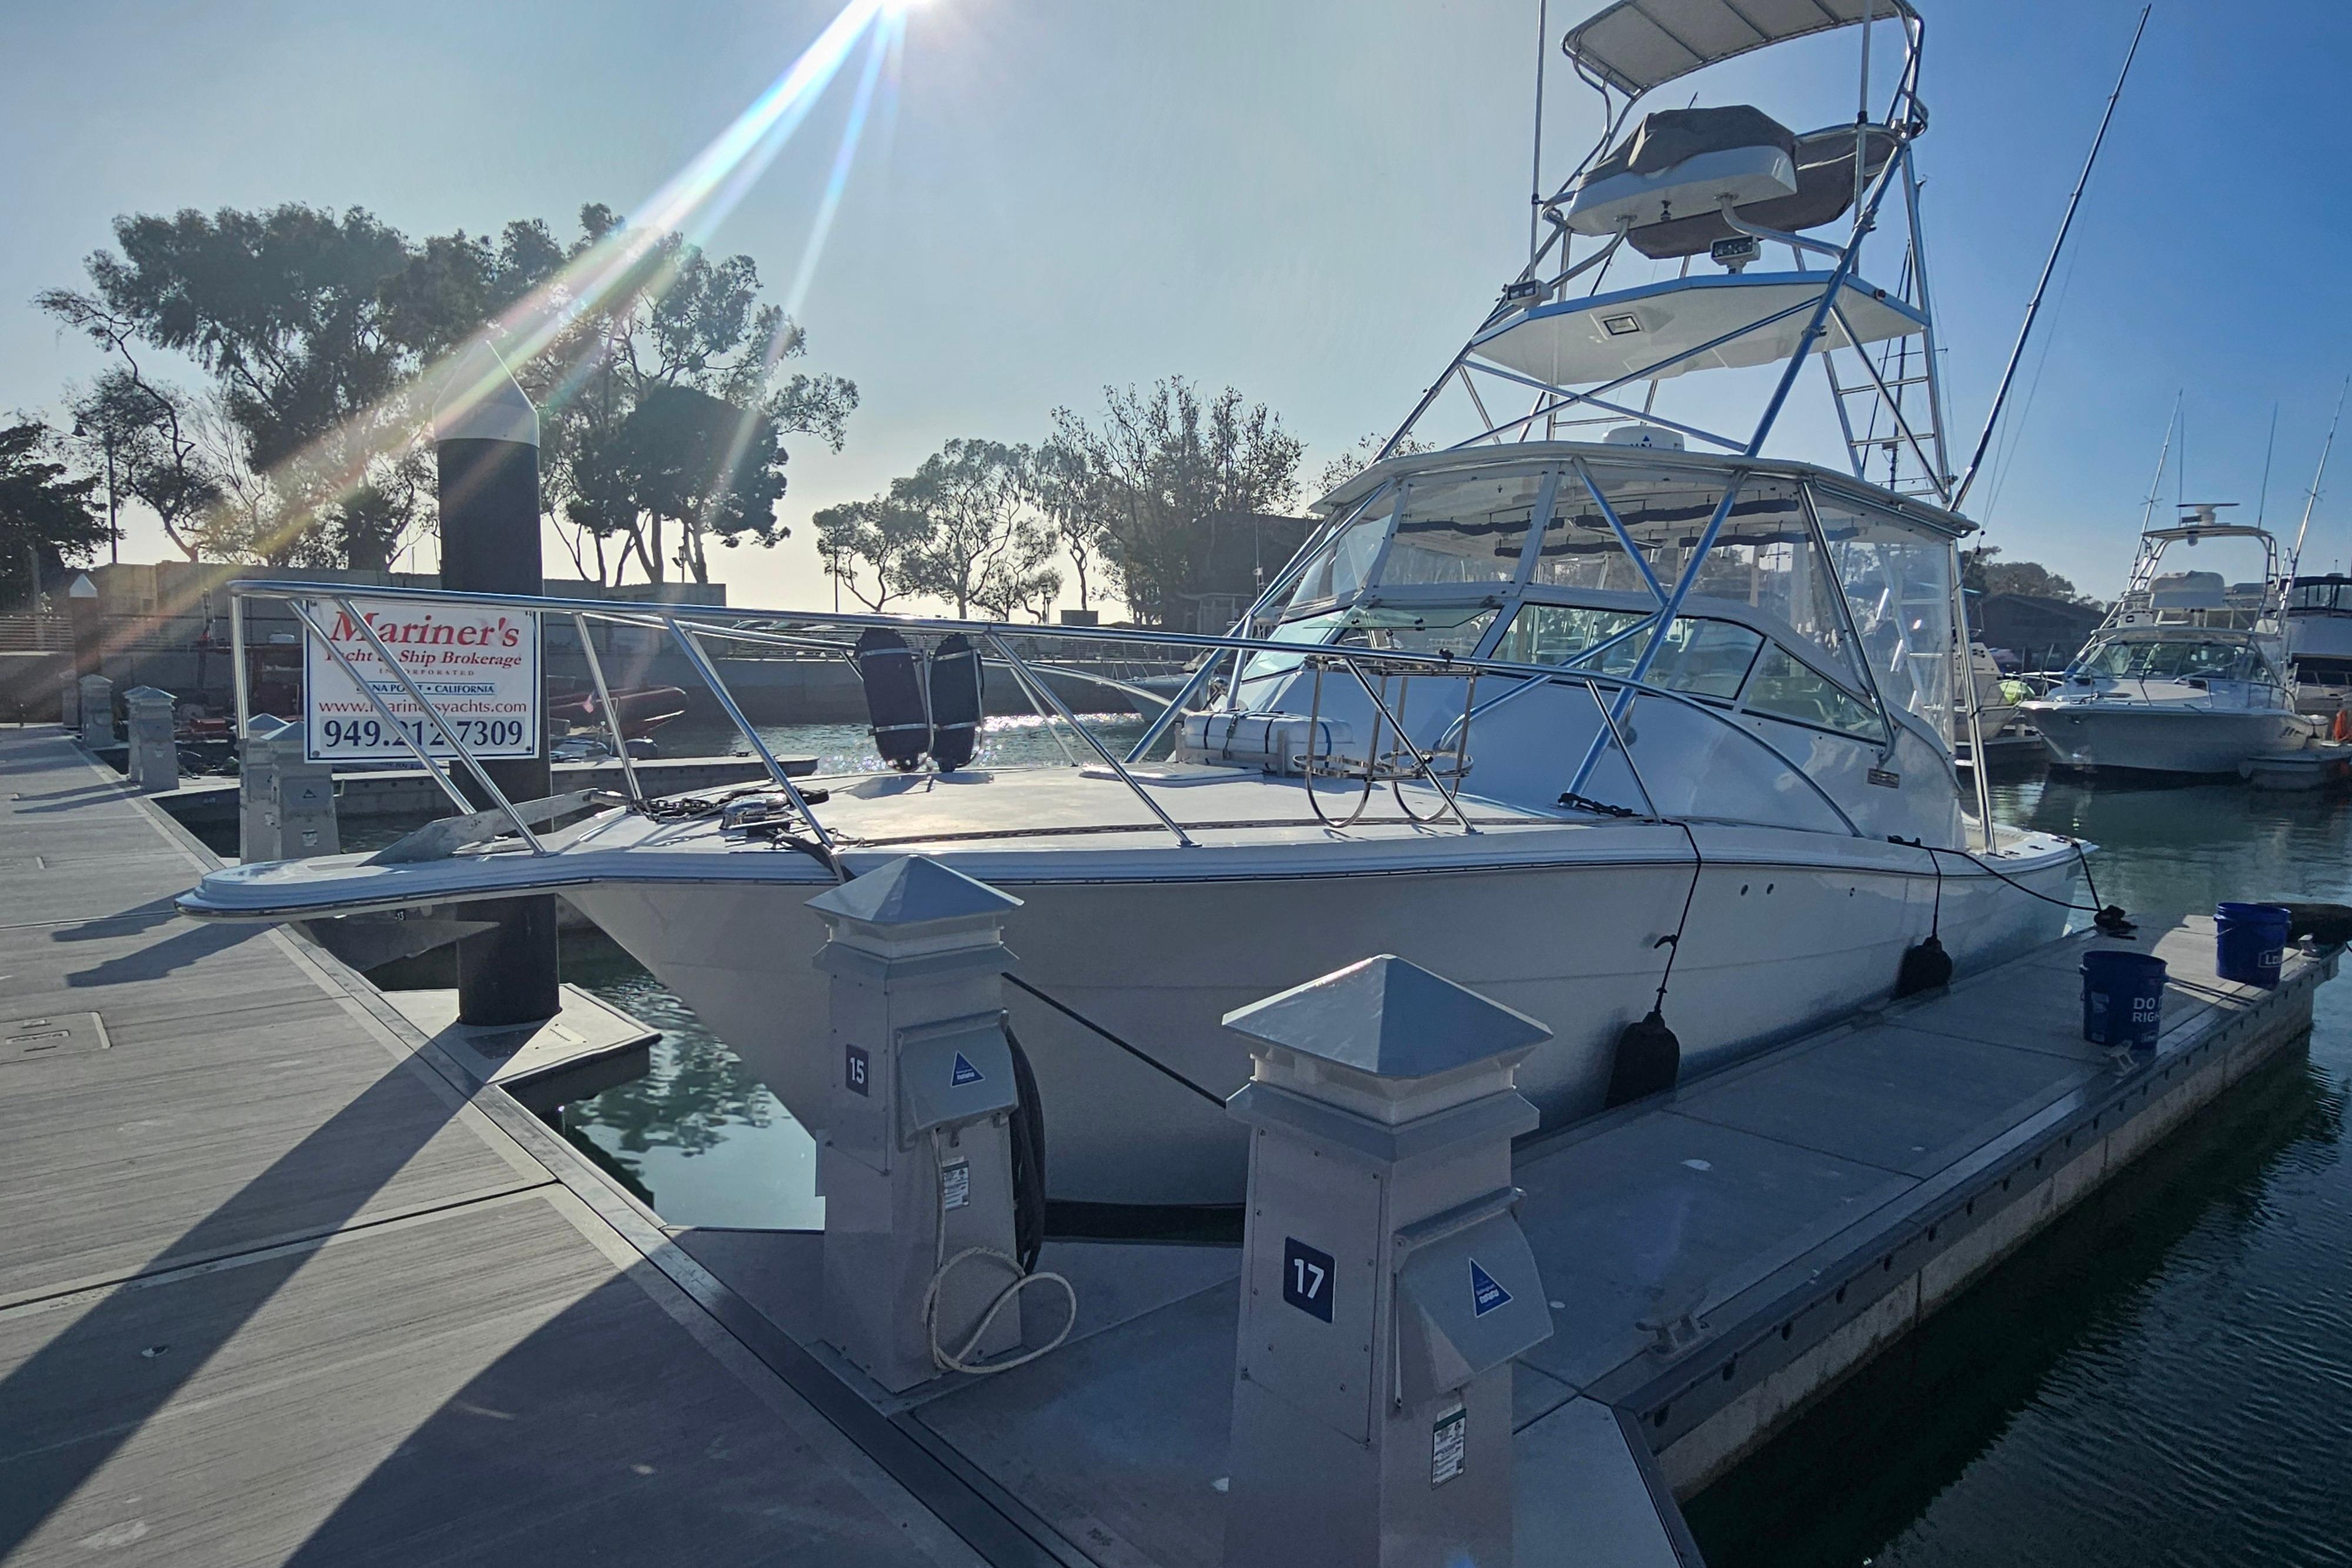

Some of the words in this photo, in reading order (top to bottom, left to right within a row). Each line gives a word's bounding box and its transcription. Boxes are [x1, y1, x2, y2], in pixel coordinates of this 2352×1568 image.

[330, 611, 519, 647] Mariner's
[326, 648, 372, 661] cht
[399, 650, 436, 667] Ship
[442, 651, 522, 669] Brokerage
[356, 684, 388, 693] NA
[390, 684, 423, 693] POT
[435, 684, 495, 693] CALIFORNIA
[319, 699, 527, 717] www.arinsyachts.com
[324, 720, 523, 747] 949.2127309
[2133, 997, 2156, 1009] DO
[850, 1057, 864, 1084] 15
[1294, 1259, 1324, 1299] 17
